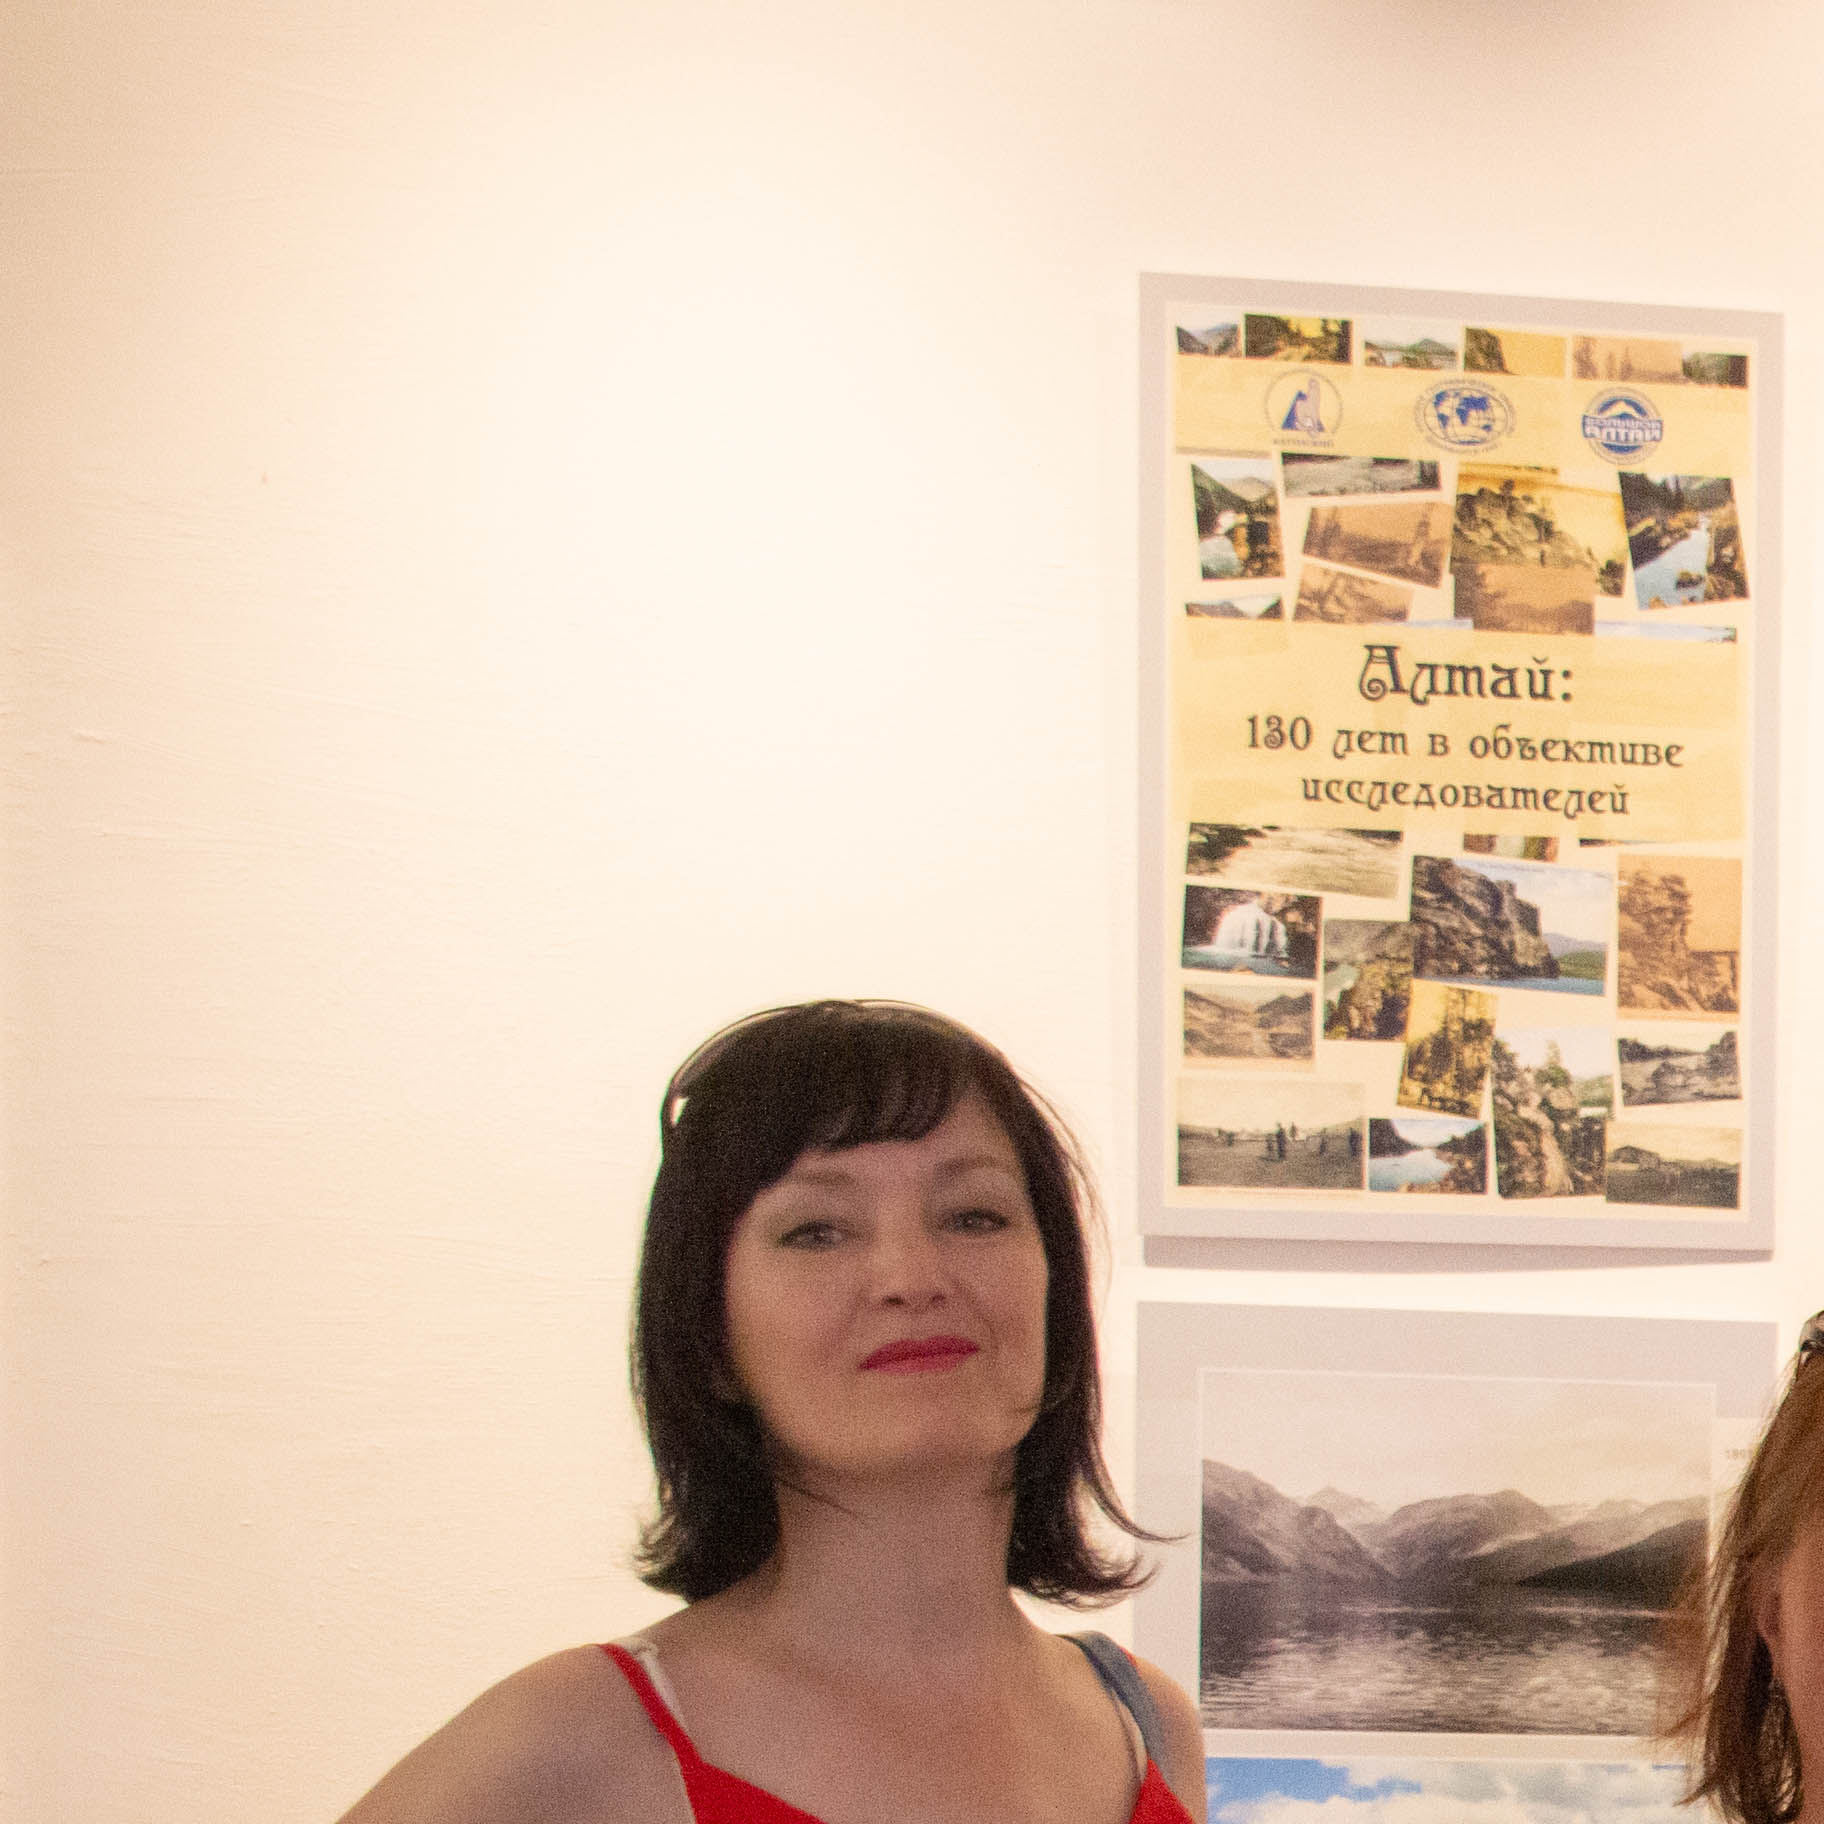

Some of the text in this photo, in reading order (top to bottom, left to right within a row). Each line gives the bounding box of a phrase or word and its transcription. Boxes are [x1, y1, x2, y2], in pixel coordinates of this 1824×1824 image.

[1359, 644, 1574, 704] Алтай:
[1247, 715, 1684, 767] 130 лет в объективе
[1302, 778, 1629, 817] исследователей
